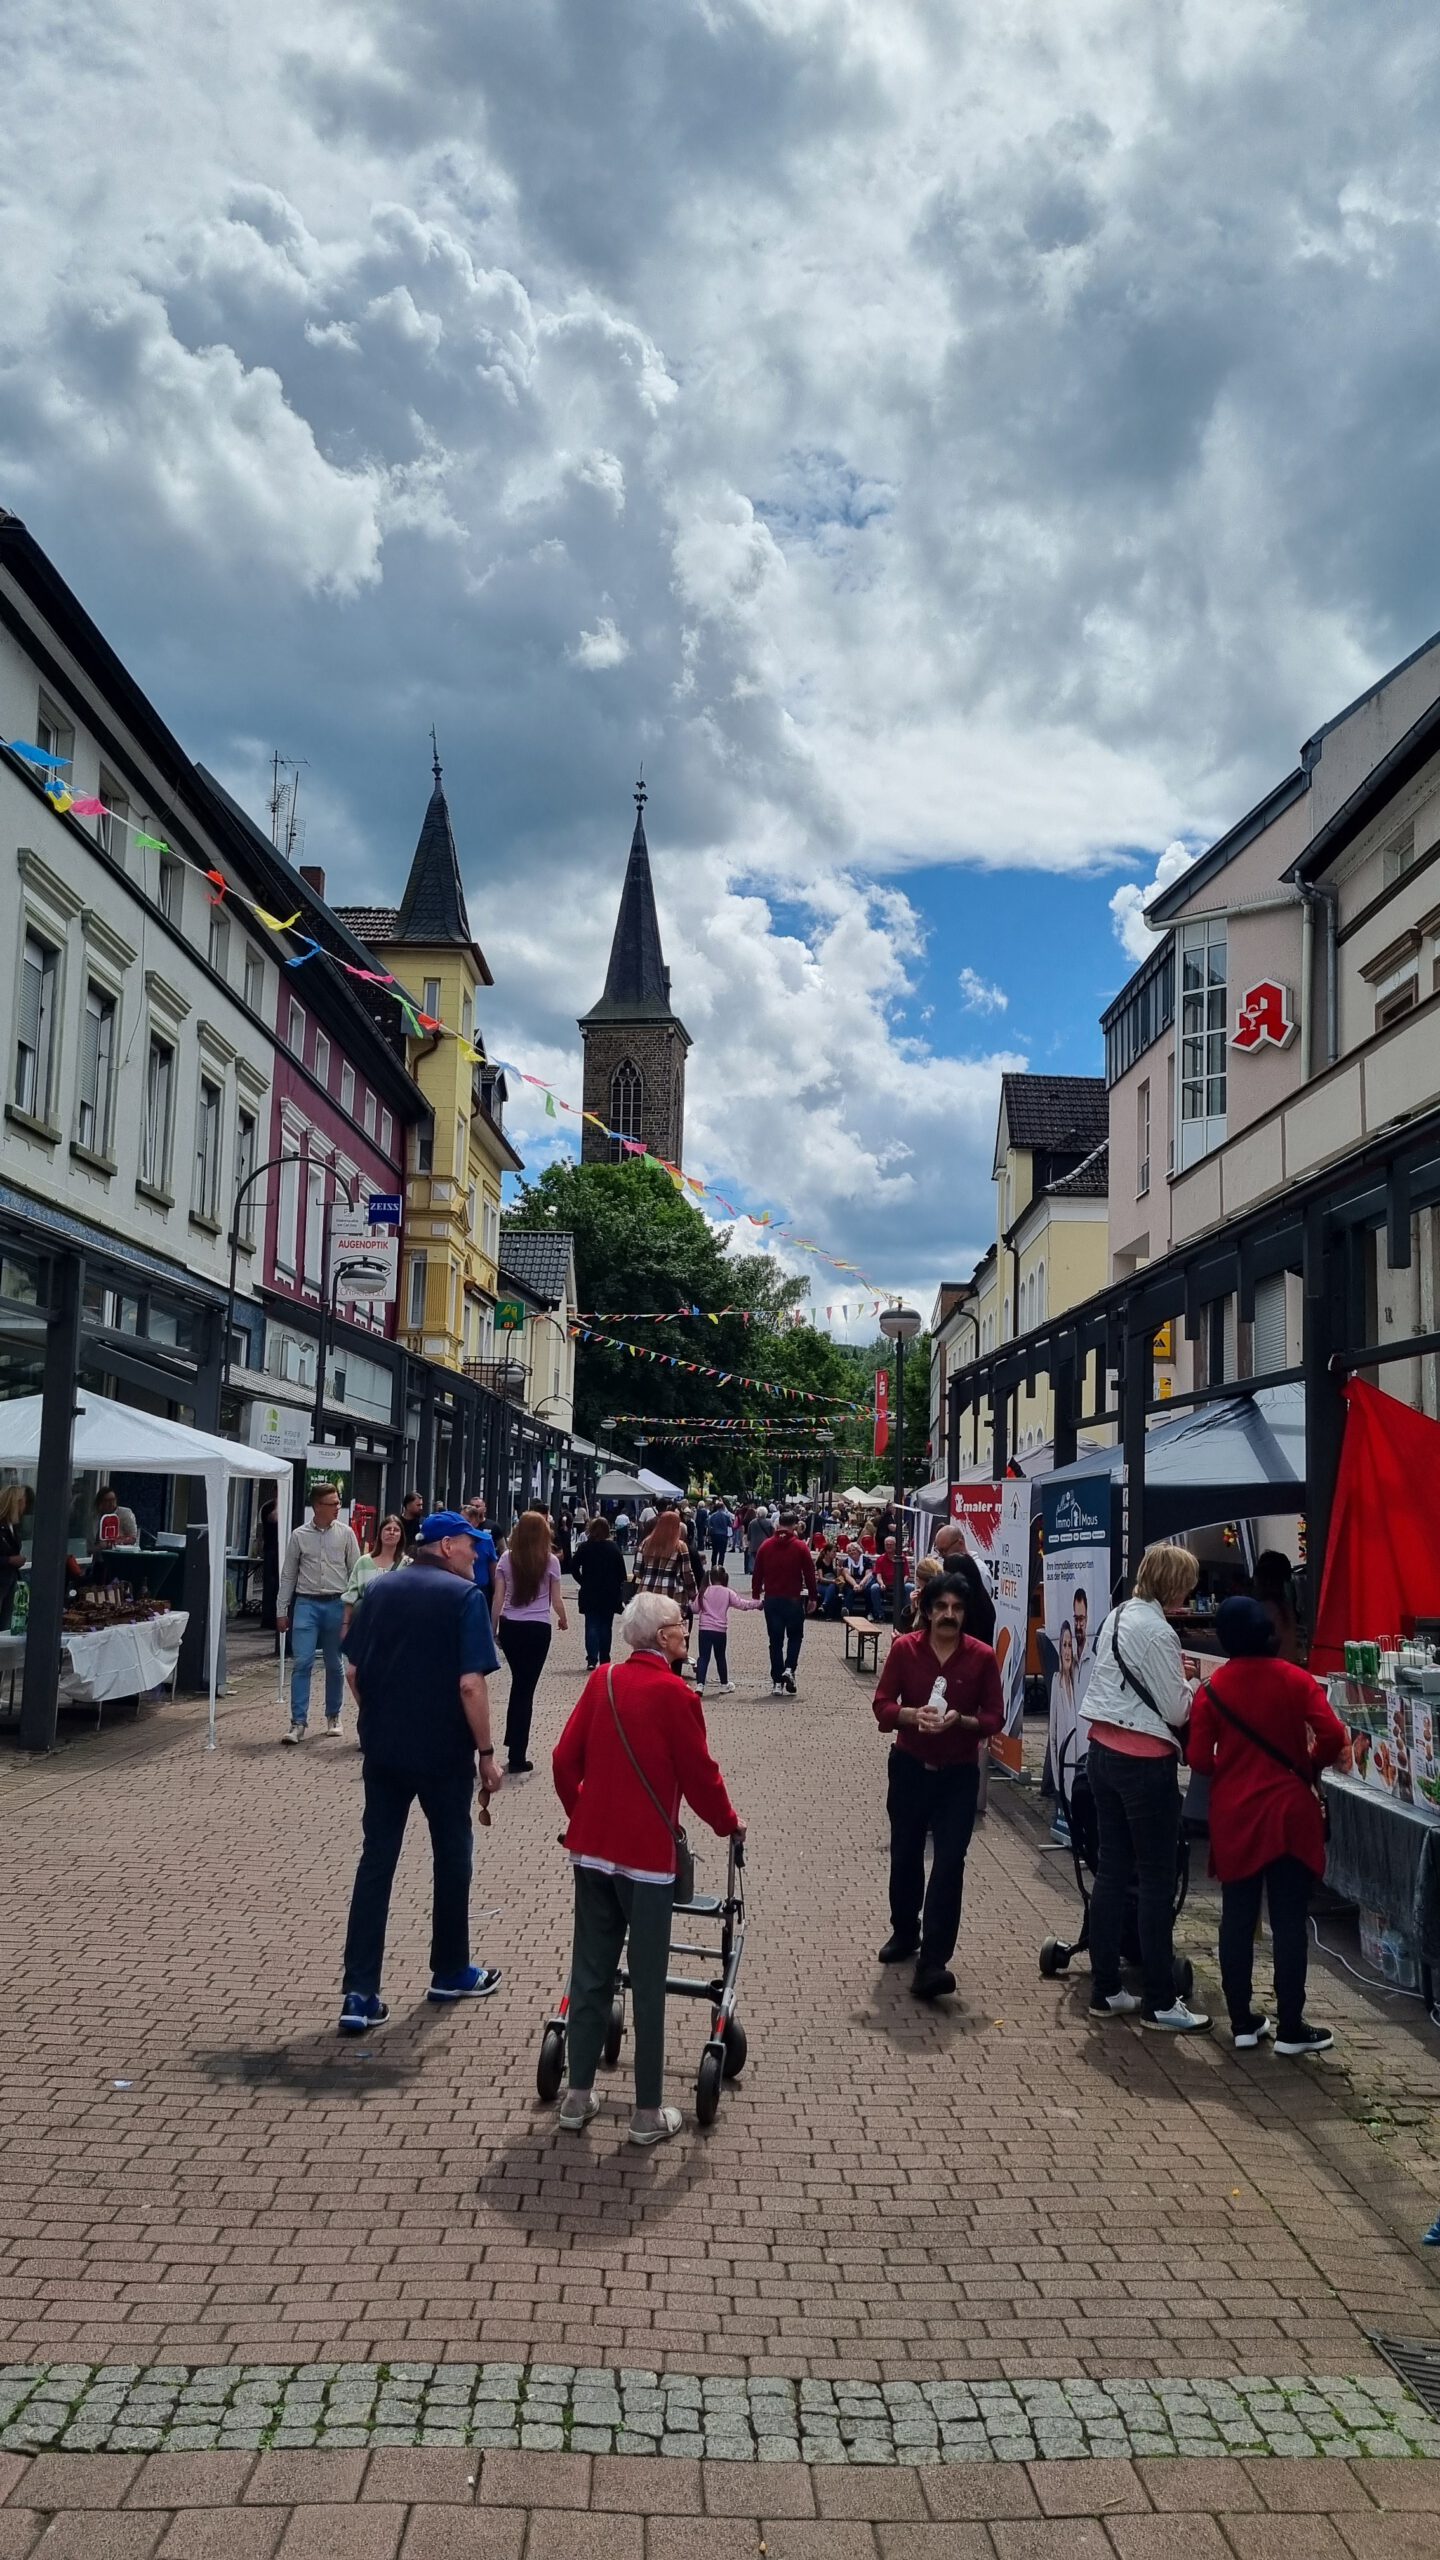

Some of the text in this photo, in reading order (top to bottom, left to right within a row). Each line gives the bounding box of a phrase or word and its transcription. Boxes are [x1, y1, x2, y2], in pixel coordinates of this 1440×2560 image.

[370, 1202, 400, 1211] ZEISS
[338, 1239, 389, 1250] AUGENOPTIK
[963, 1501, 993, 1512] maler
[1056, 1516, 1071, 1528] Immo
[1081, 1513, 1098, 1526] Maus
